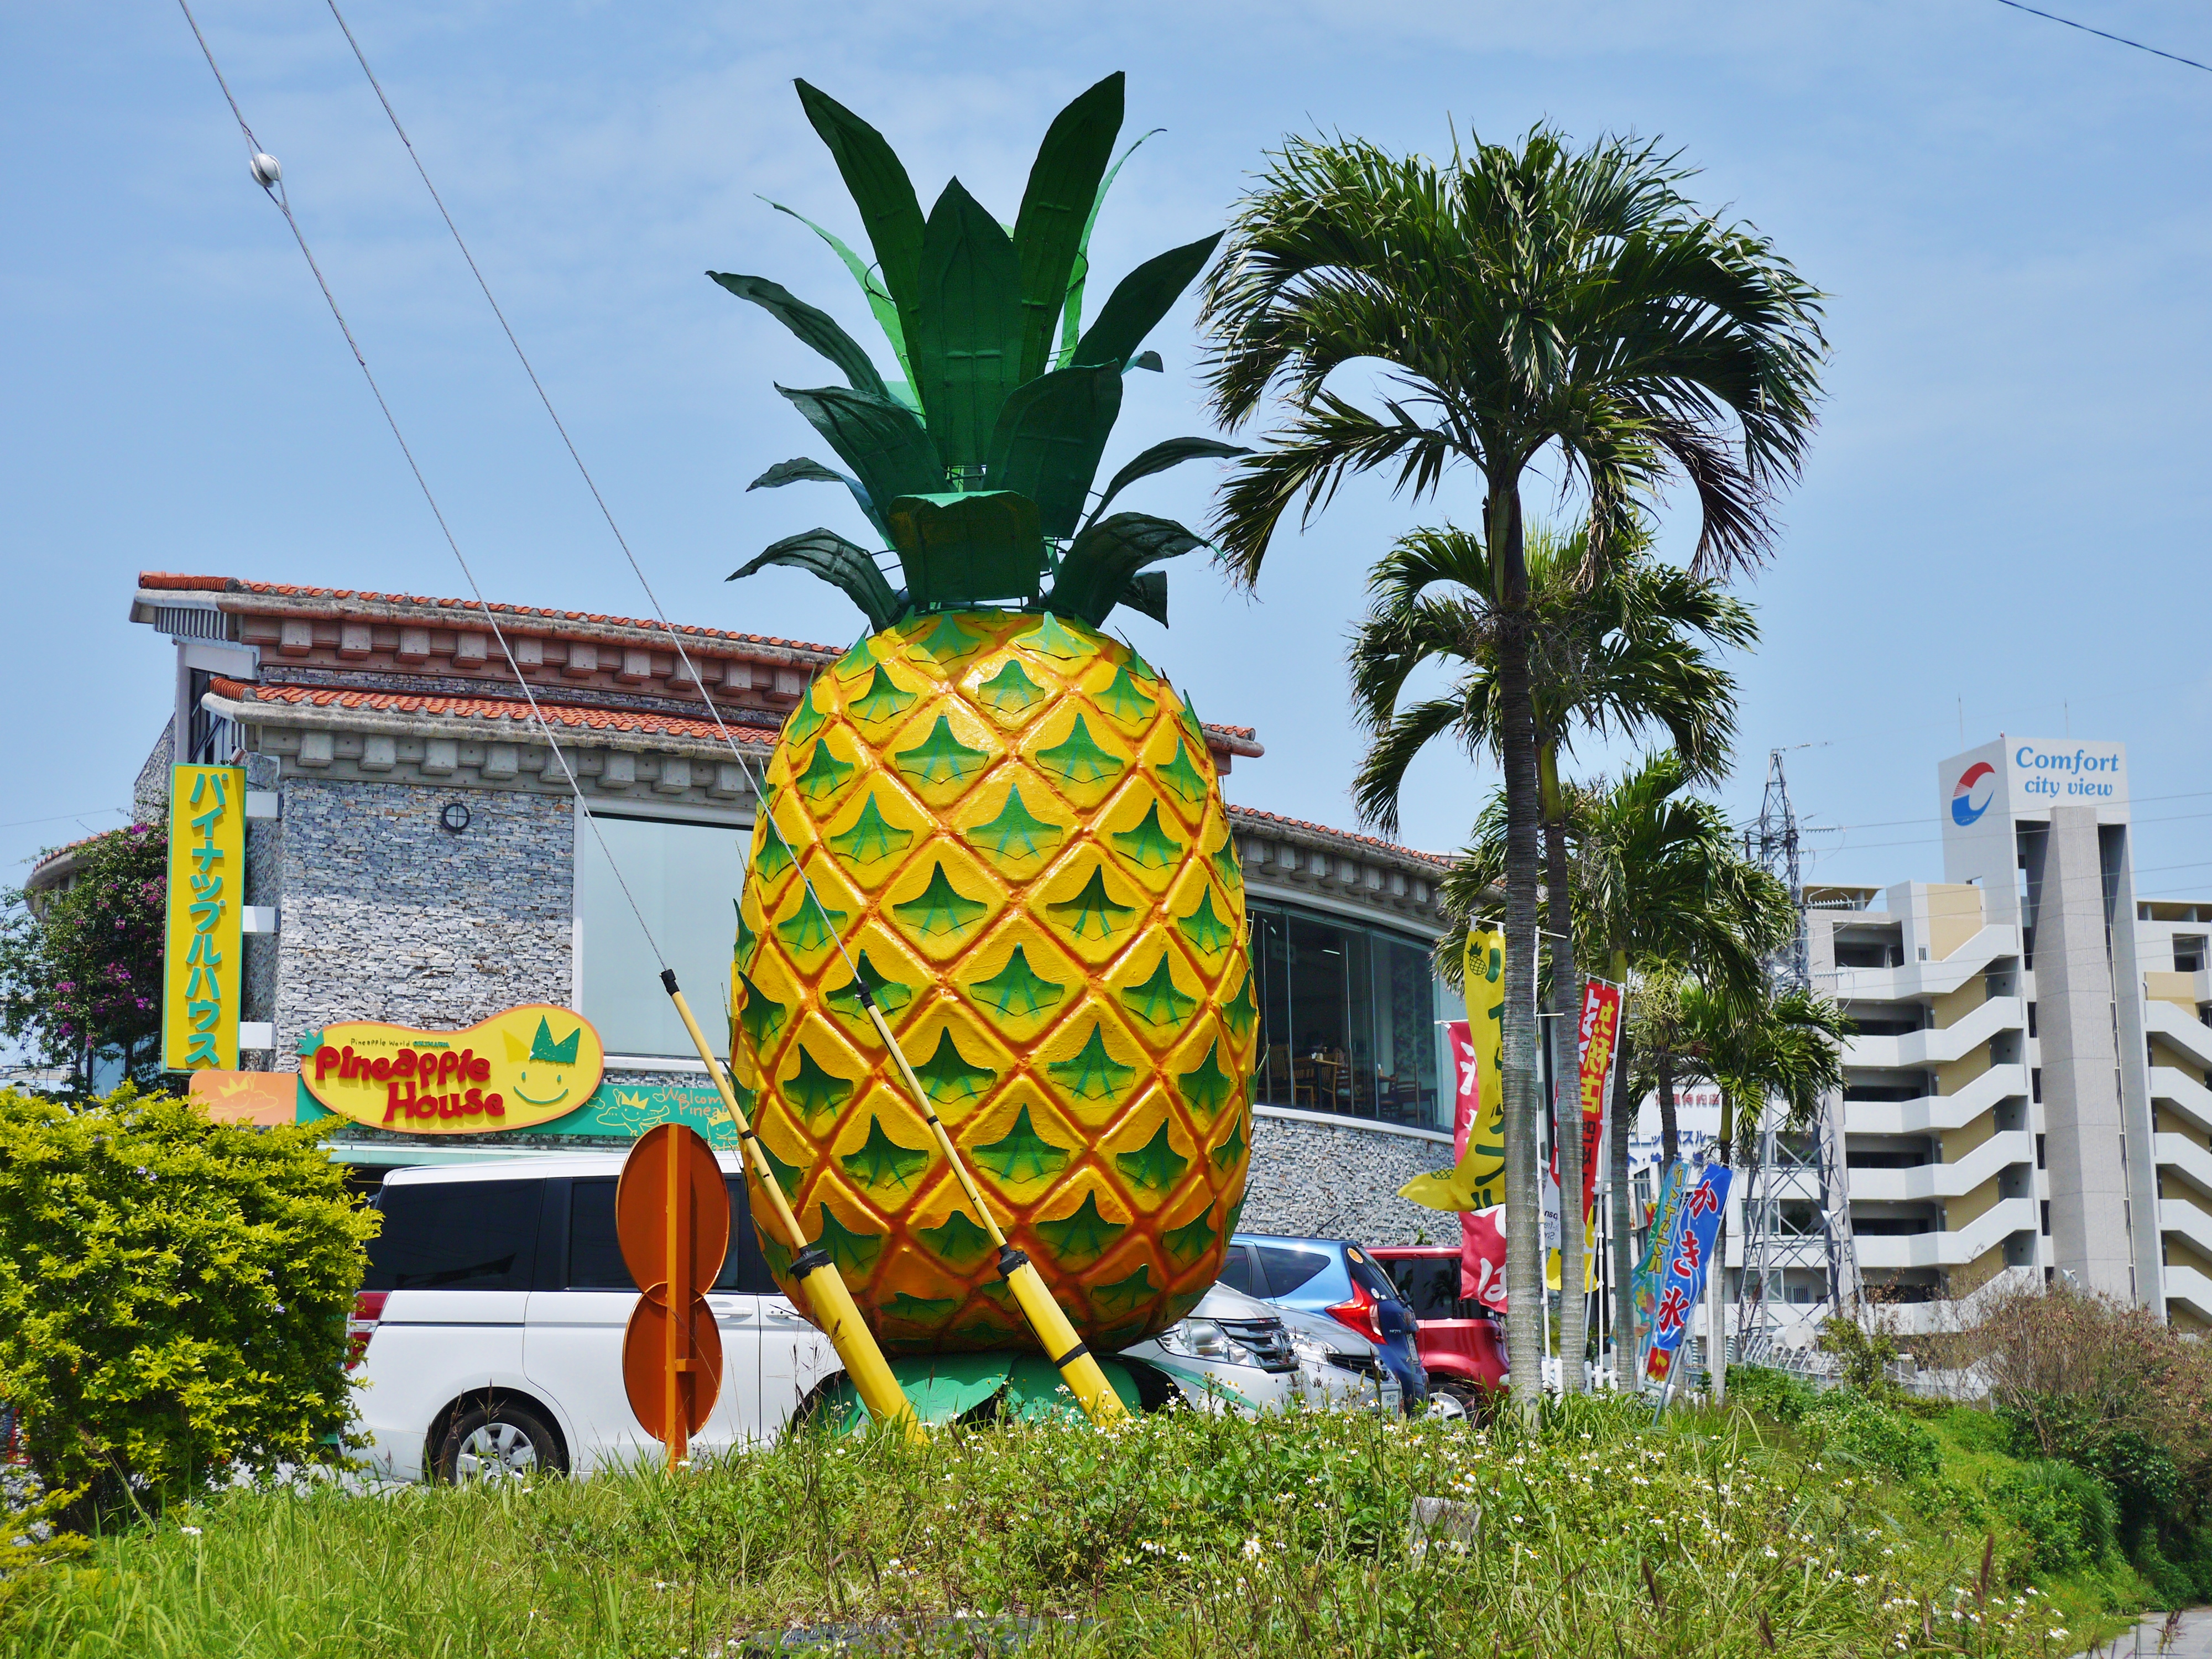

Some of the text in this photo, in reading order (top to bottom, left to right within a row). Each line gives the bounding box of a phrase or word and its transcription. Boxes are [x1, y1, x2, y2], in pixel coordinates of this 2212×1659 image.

[2016, 747, 2119, 775] Comfort
[2025, 776, 2112, 797] city view
[185, 772, 228, 1065] パイナップルハウス
[351, 1038, 386, 1047] Pineapple
[315, 1045, 491, 1089] Pineapple
[383, 1081, 505, 1123] House
[662, 1087, 724, 1104] Welcom
[678, 1098, 728, 1117] Pineap
[1659, 1180, 1718, 1334] かき氷
